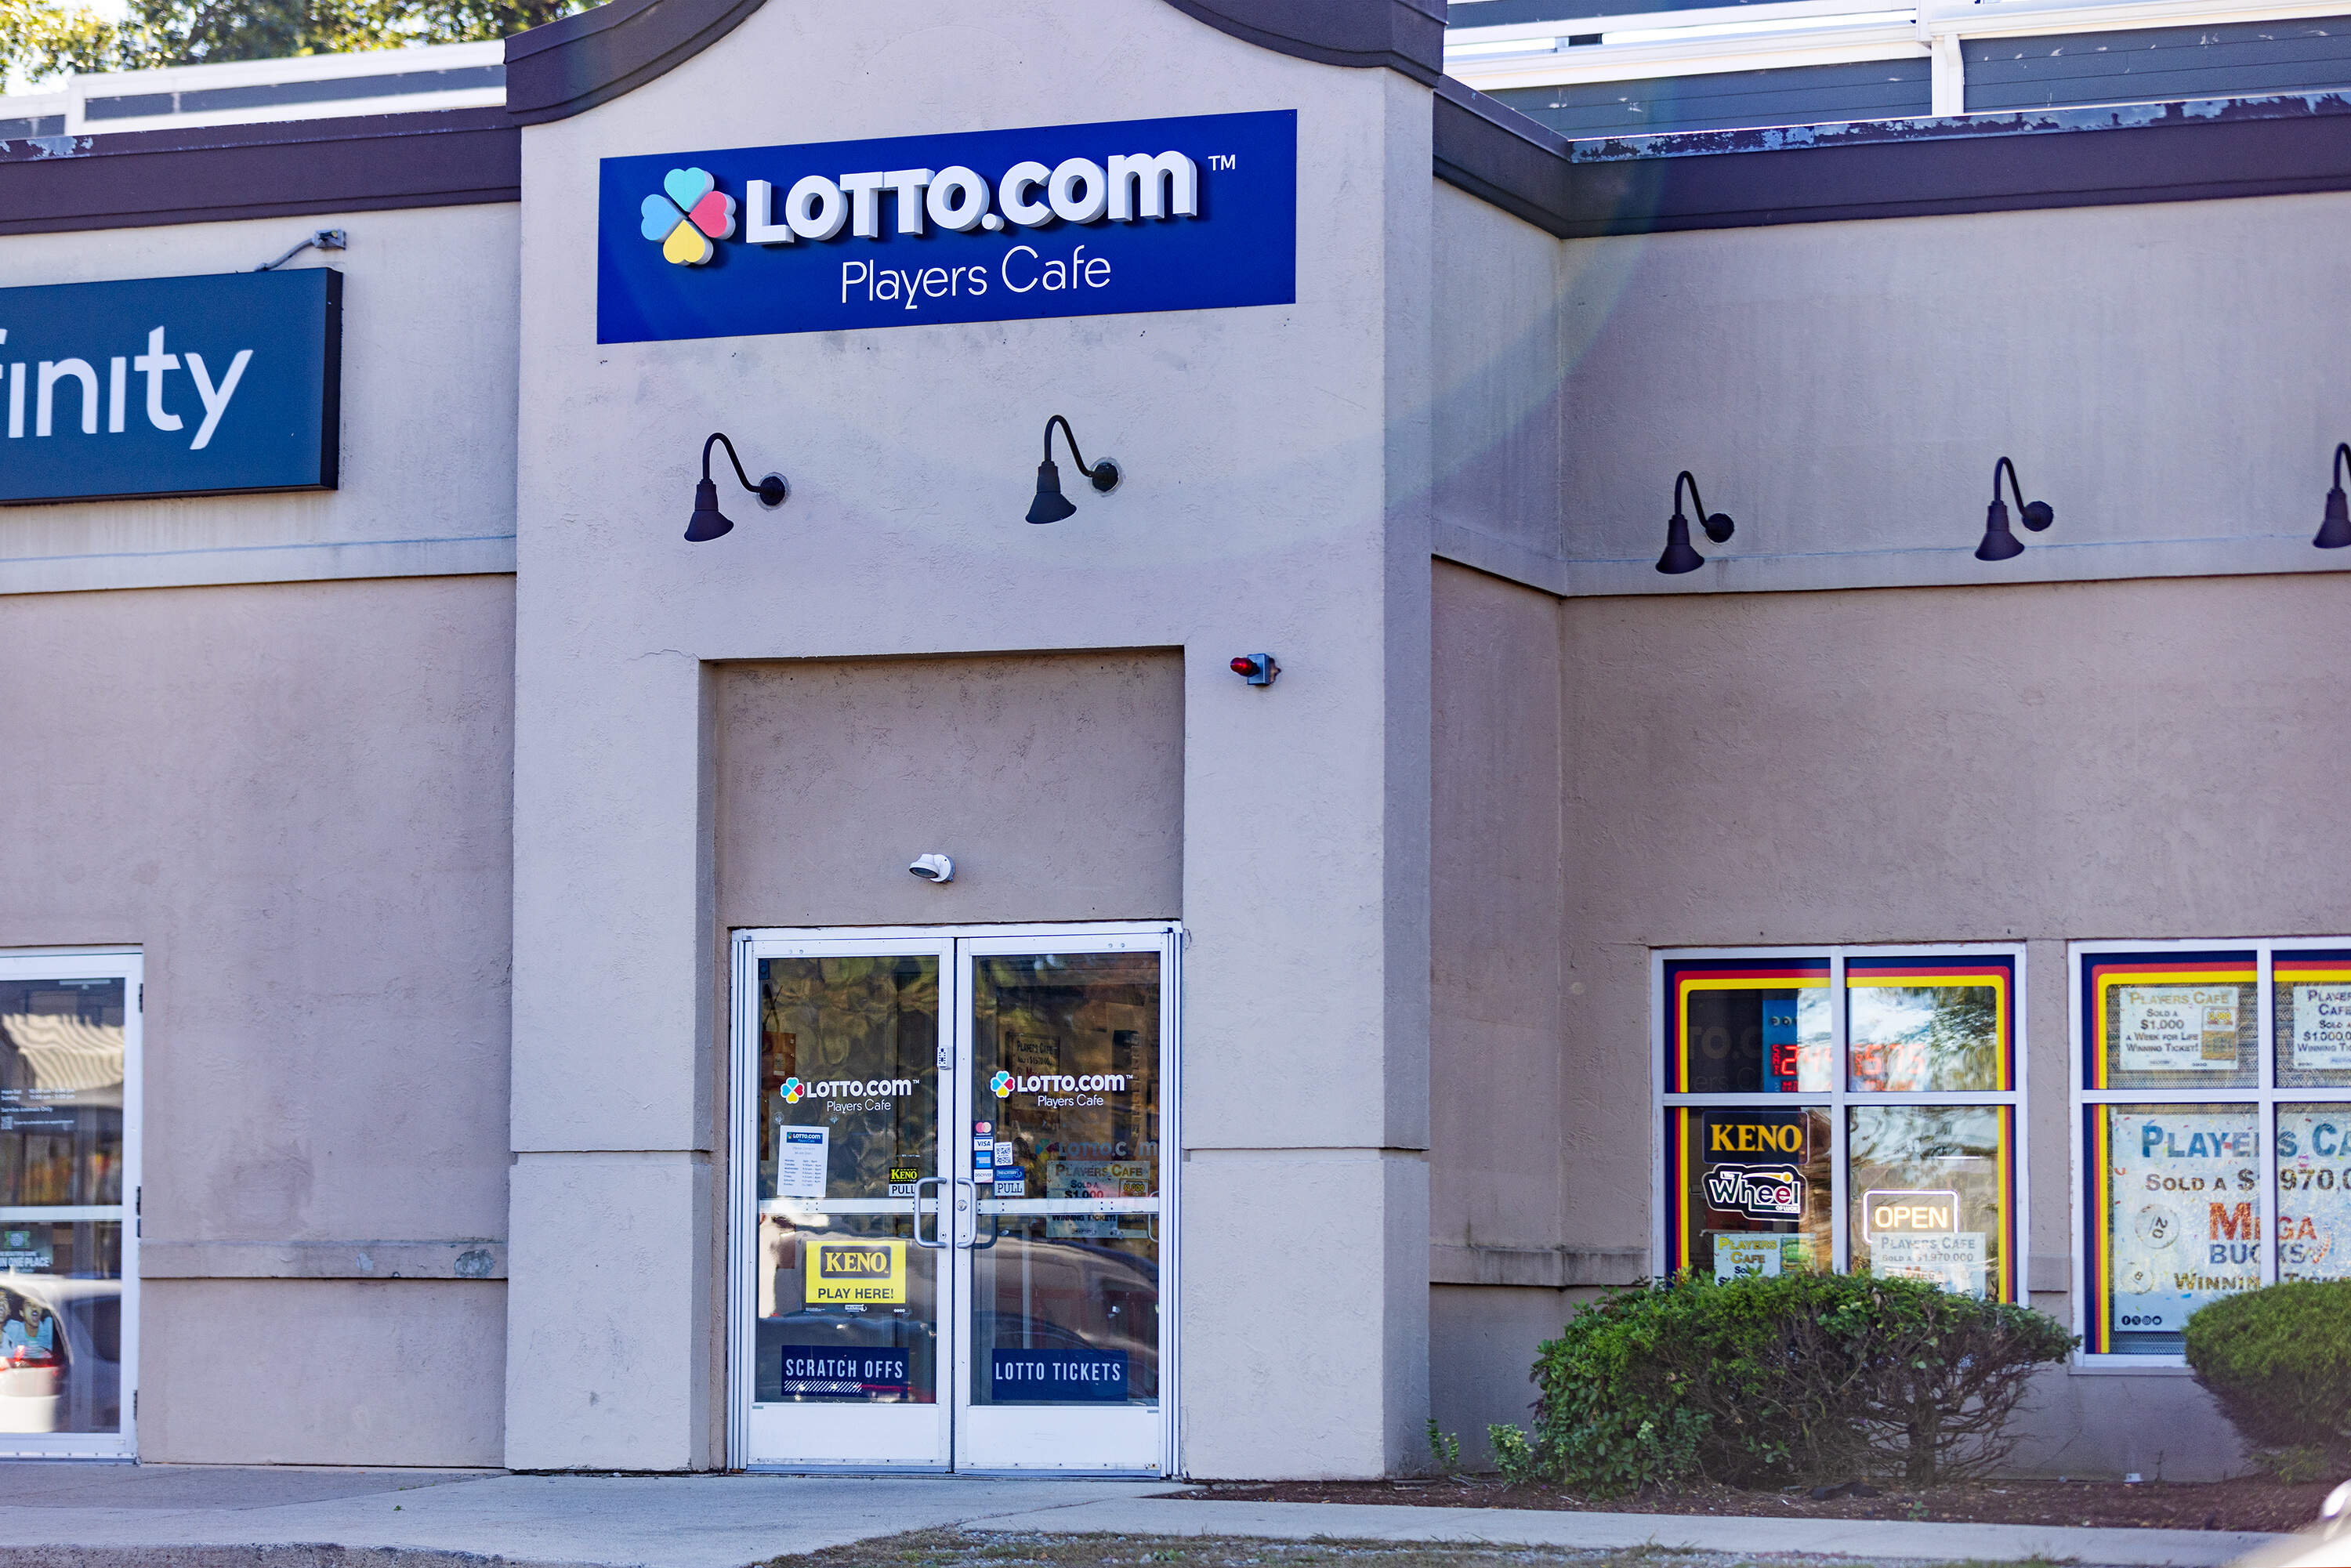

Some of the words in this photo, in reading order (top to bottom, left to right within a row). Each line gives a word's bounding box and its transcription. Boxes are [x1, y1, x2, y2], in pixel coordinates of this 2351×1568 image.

[746, 150, 1197, 244] LOTTO.com
[842, 259, 987, 310] Players
[1002, 245, 1110, 293] Cafe
[2130, 991, 2189, 1004] PLAYERS
[2194, 991, 2229, 1004] CAFE
[2146, 1009, 2169, 1017] SOLD
[2141, 1019, 2184, 1030] $1,000
[2134, 1032, 2158, 1041] WEEK
[2181, 1032, 2198, 1041] LIFE
[806, 1079, 912, 1097] LOTTO.com
[1017, 1074, 1125, 1092] LOTTO.com
[827, 1101, 862, 1114] Players
[864, 1099, 891, 1111] Cafe
[1038, 1095, 1074, 1109] Players
[1077, 1094, 1103, 1106] Cafe
[1710, 1124, 1802, 1153] KENO
[2142, 1124, 2298, 1157] PLAYES
[891, 1168, 917, 1179] KENO
[1056, 1164, 1108, 1176] PLAYERS
[1111, 1164, 1143, 1176] CAFE
[997, 1183, 1022, 1193] PULL
[1070, 1180, 1092, 1189] SOLD
[2145, 1173, 2204, 1191] SOLD
[2213, 1177, 2226, 1190] A
[892, 1186, 915, 1194] PULL
[1065, 1190, 1103, 1198] $1000
[1708, 1171, 1801, 1211] Wheel
[1875, 1206, 1947, 1229] OPEN
[1718, 1237, 1777, 1250] PLAYERS
[1942, 1237, 1975, 1249] CAFE
[825, 1252, 886, 1273] KENO
[1730, 1251, 1766, 1263] CAFE
[818, 1288, 850, 1299] PLAY
[855, 1288, 893, 1299] HERE!
[786, 1359, 857, 1377] SCRATCH
[864, 1360, 903, 1378] OFFS
[995, 1362, 1045, 1380] LOTTO
[1052, 1362, 1121, 1382] TICKETS
